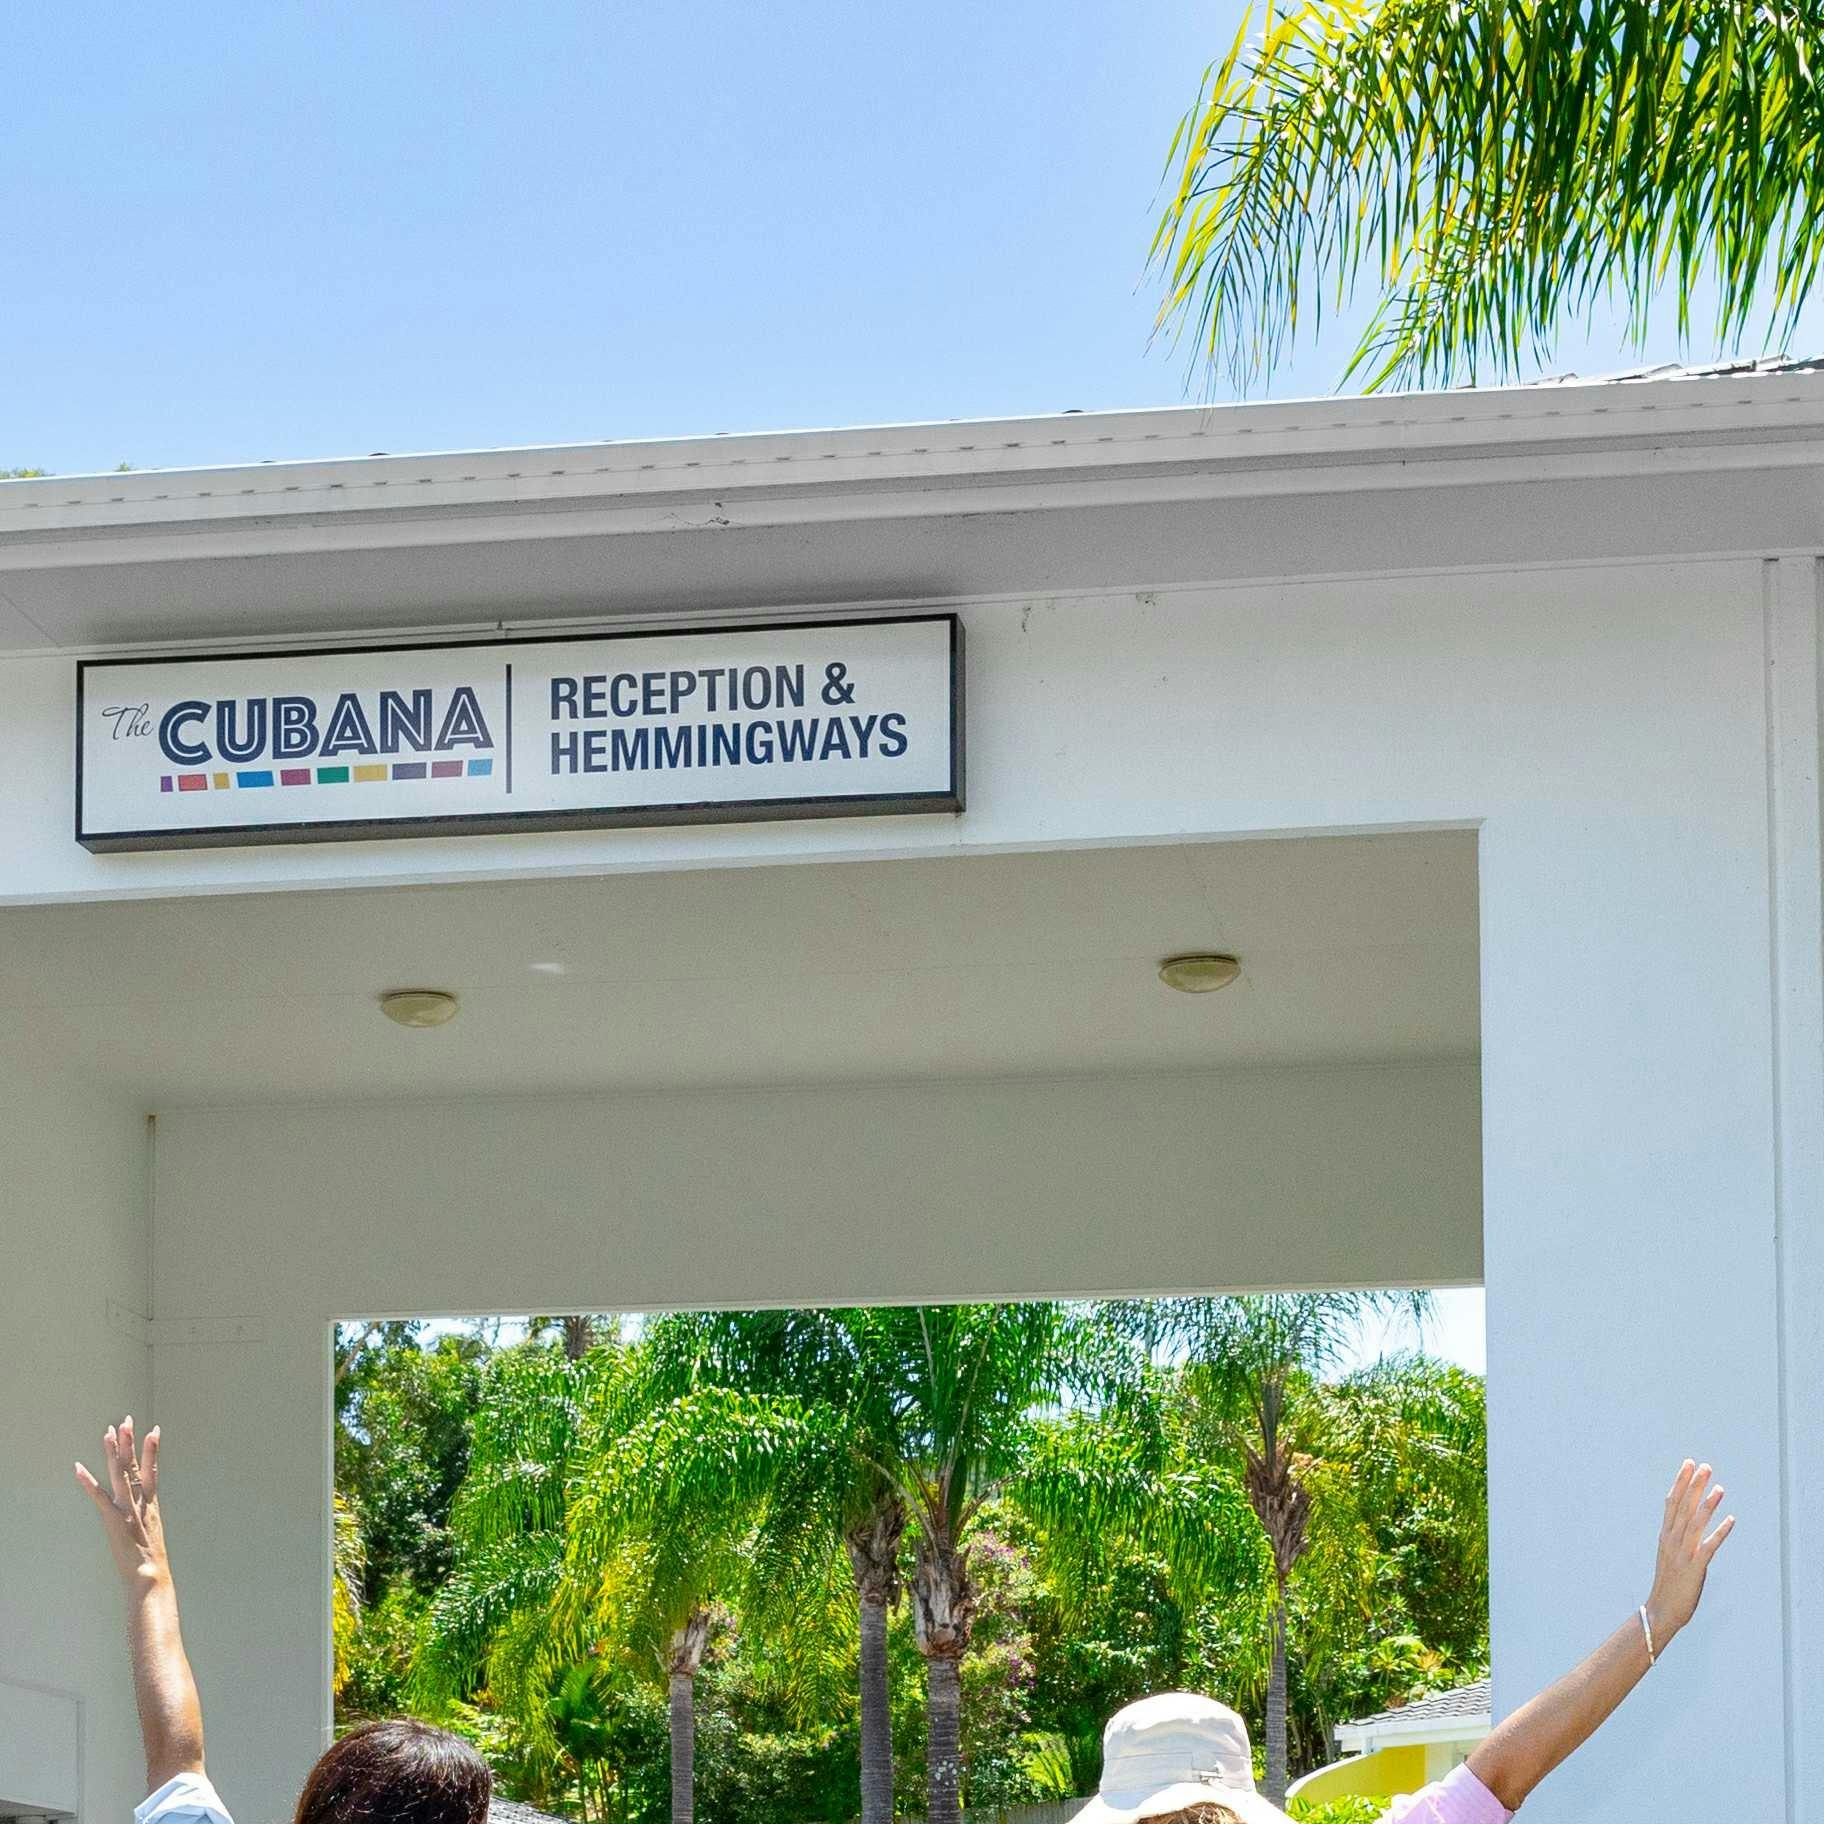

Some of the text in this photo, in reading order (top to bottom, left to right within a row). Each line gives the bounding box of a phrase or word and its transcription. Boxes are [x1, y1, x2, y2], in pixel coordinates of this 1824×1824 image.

[550, 662, 856, 720] RECEPTION &
[101, 686, 495, 766] The CUBANA
[550, 713, 909, 775] HEMMINGWAYS
